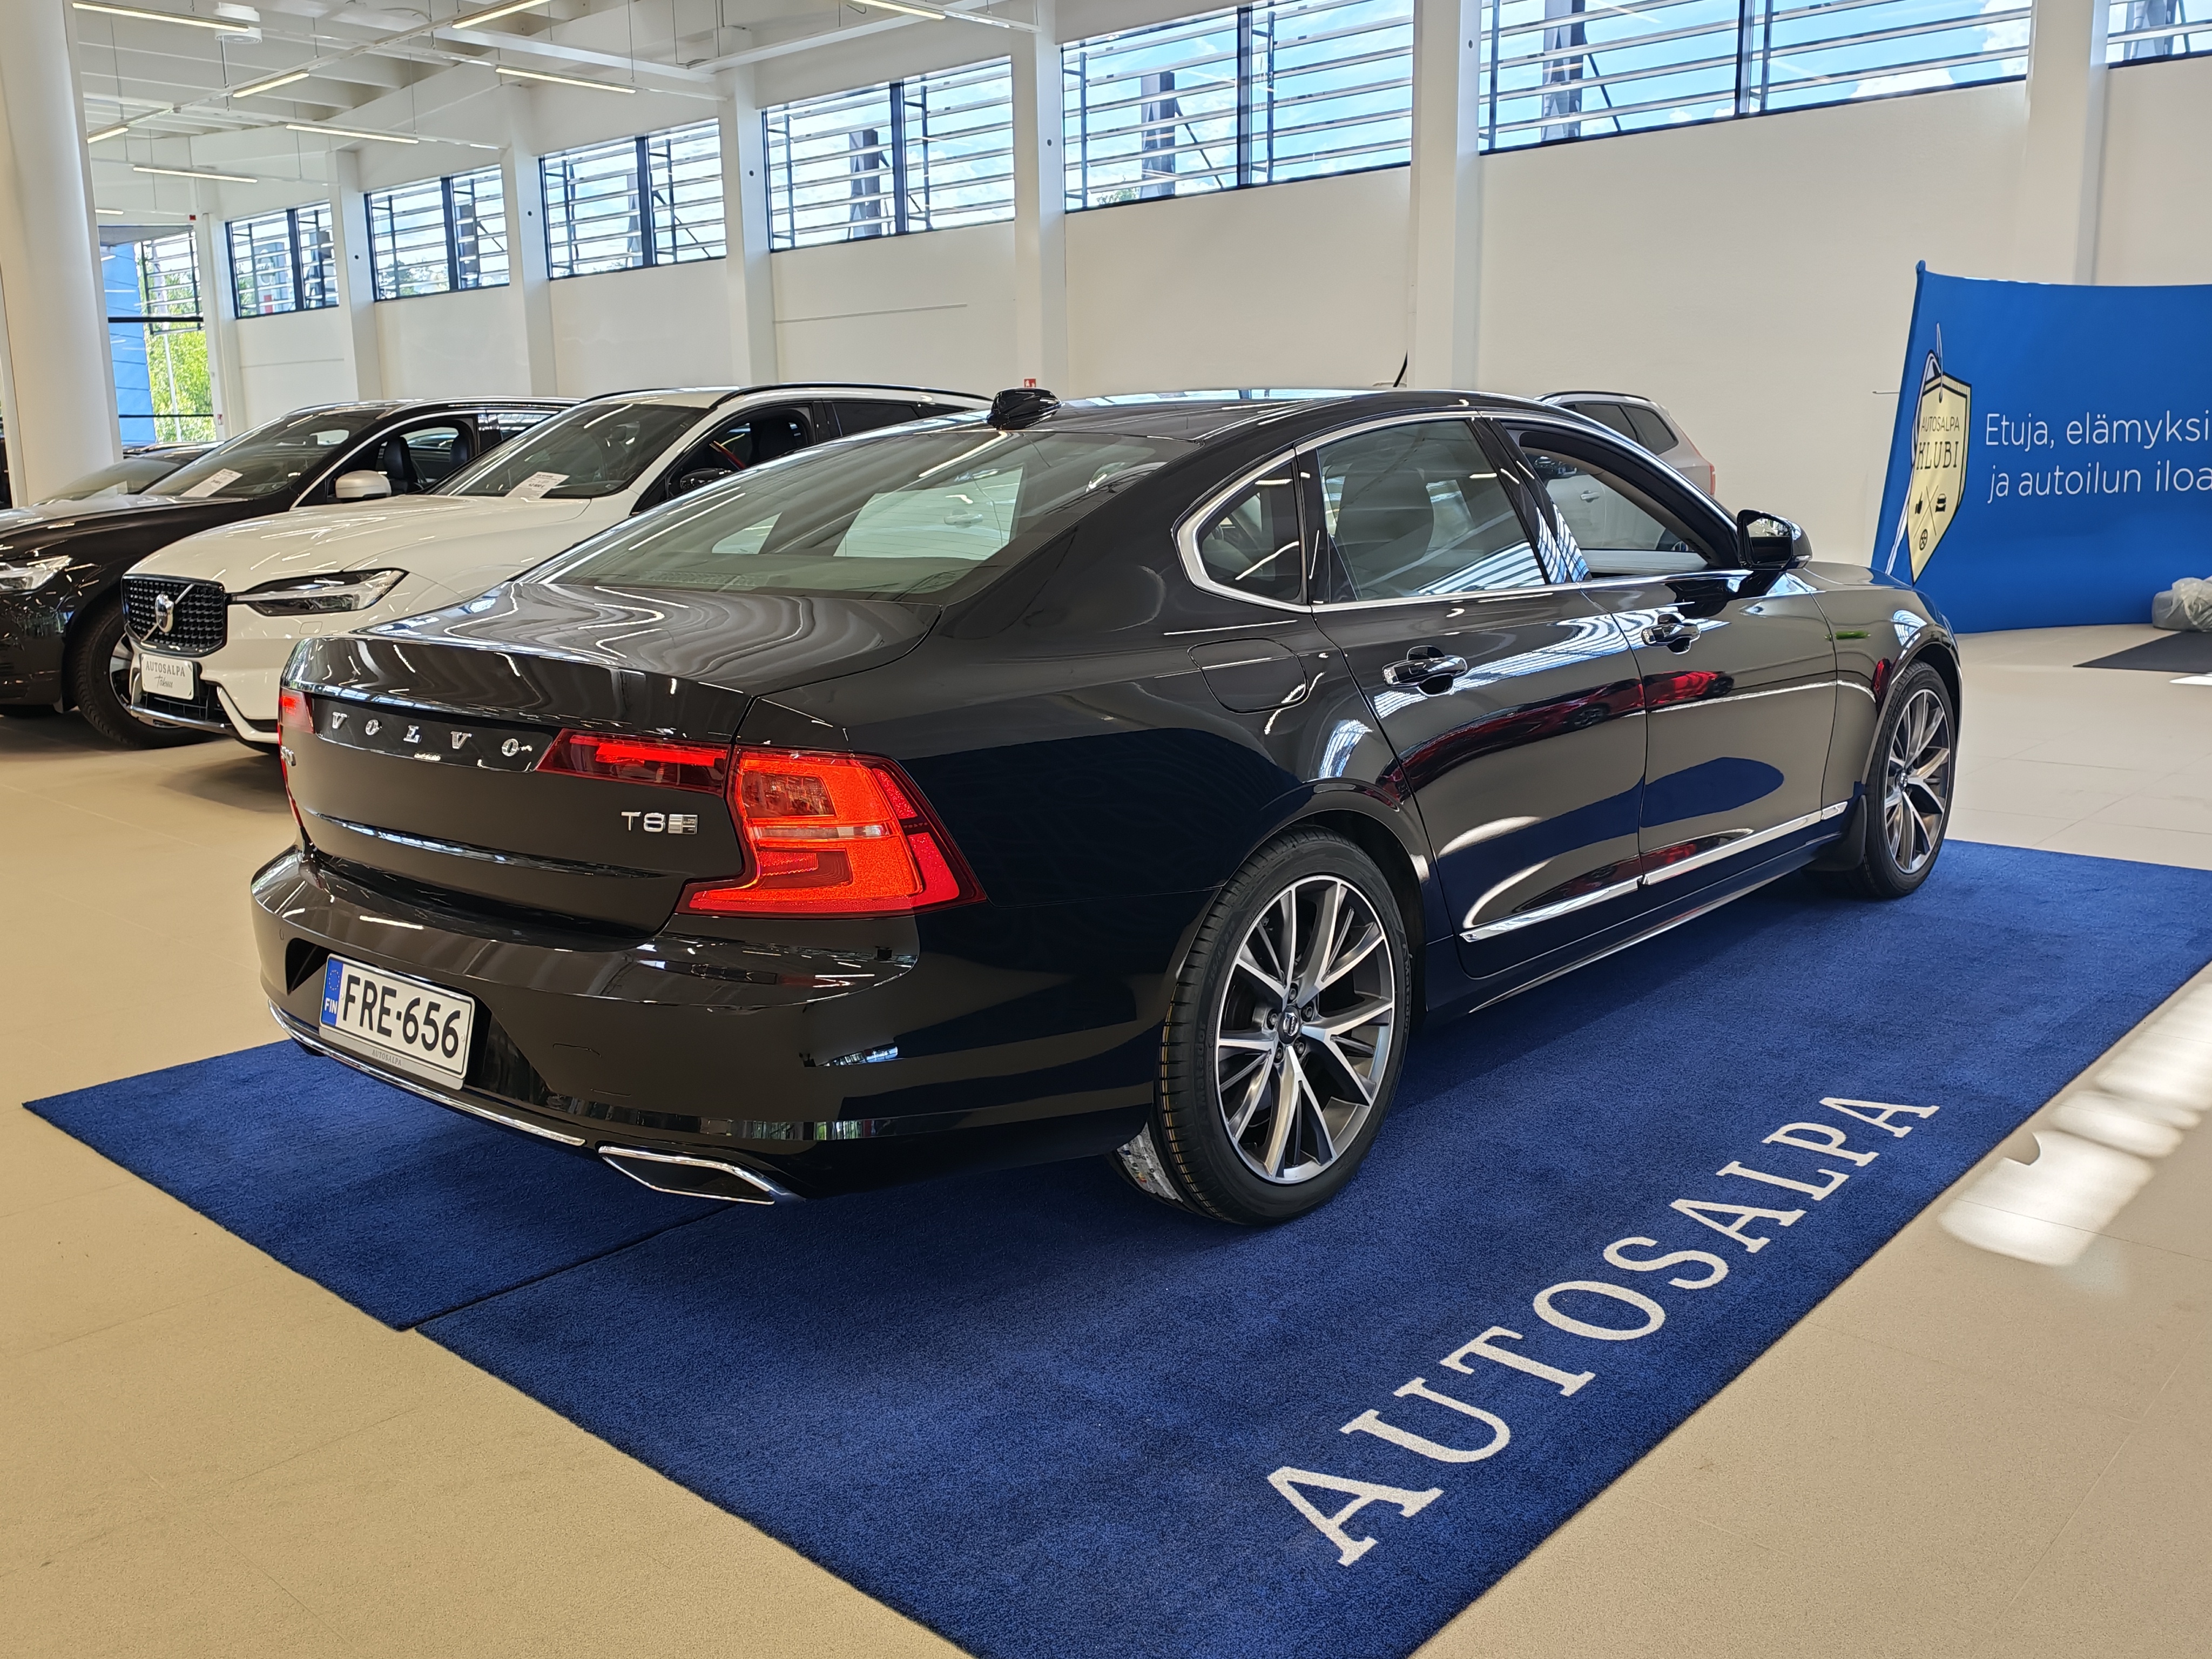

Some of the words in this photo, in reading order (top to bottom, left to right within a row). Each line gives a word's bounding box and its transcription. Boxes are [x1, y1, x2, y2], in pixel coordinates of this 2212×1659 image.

[1921, 416, 1960, 432] AUTOSALPA
[1985, 413, 2054, 452] Etuja,
[2066, 409, 2210, 449] elämyksi
[1916, 441, 1959, 470] KLUBI
[1987, 464, 2009, 504] ja
[2018, 461, 2141, 496] autoilun
[2155, 459, 2212, 492] iloa
[146, 660, 185, 677] AUTOSALPA
[331, 711, 522, 758] VOLVO
[621, 811, 666, 832] T8
[325, 997, 338, 1015] FIN
[343, 974, 461, 1058] FRE-656
[372, 1049, 402, 1066] AUTOSALPA
[1267, 1096, 1940, 1567] AUTOSALPA
